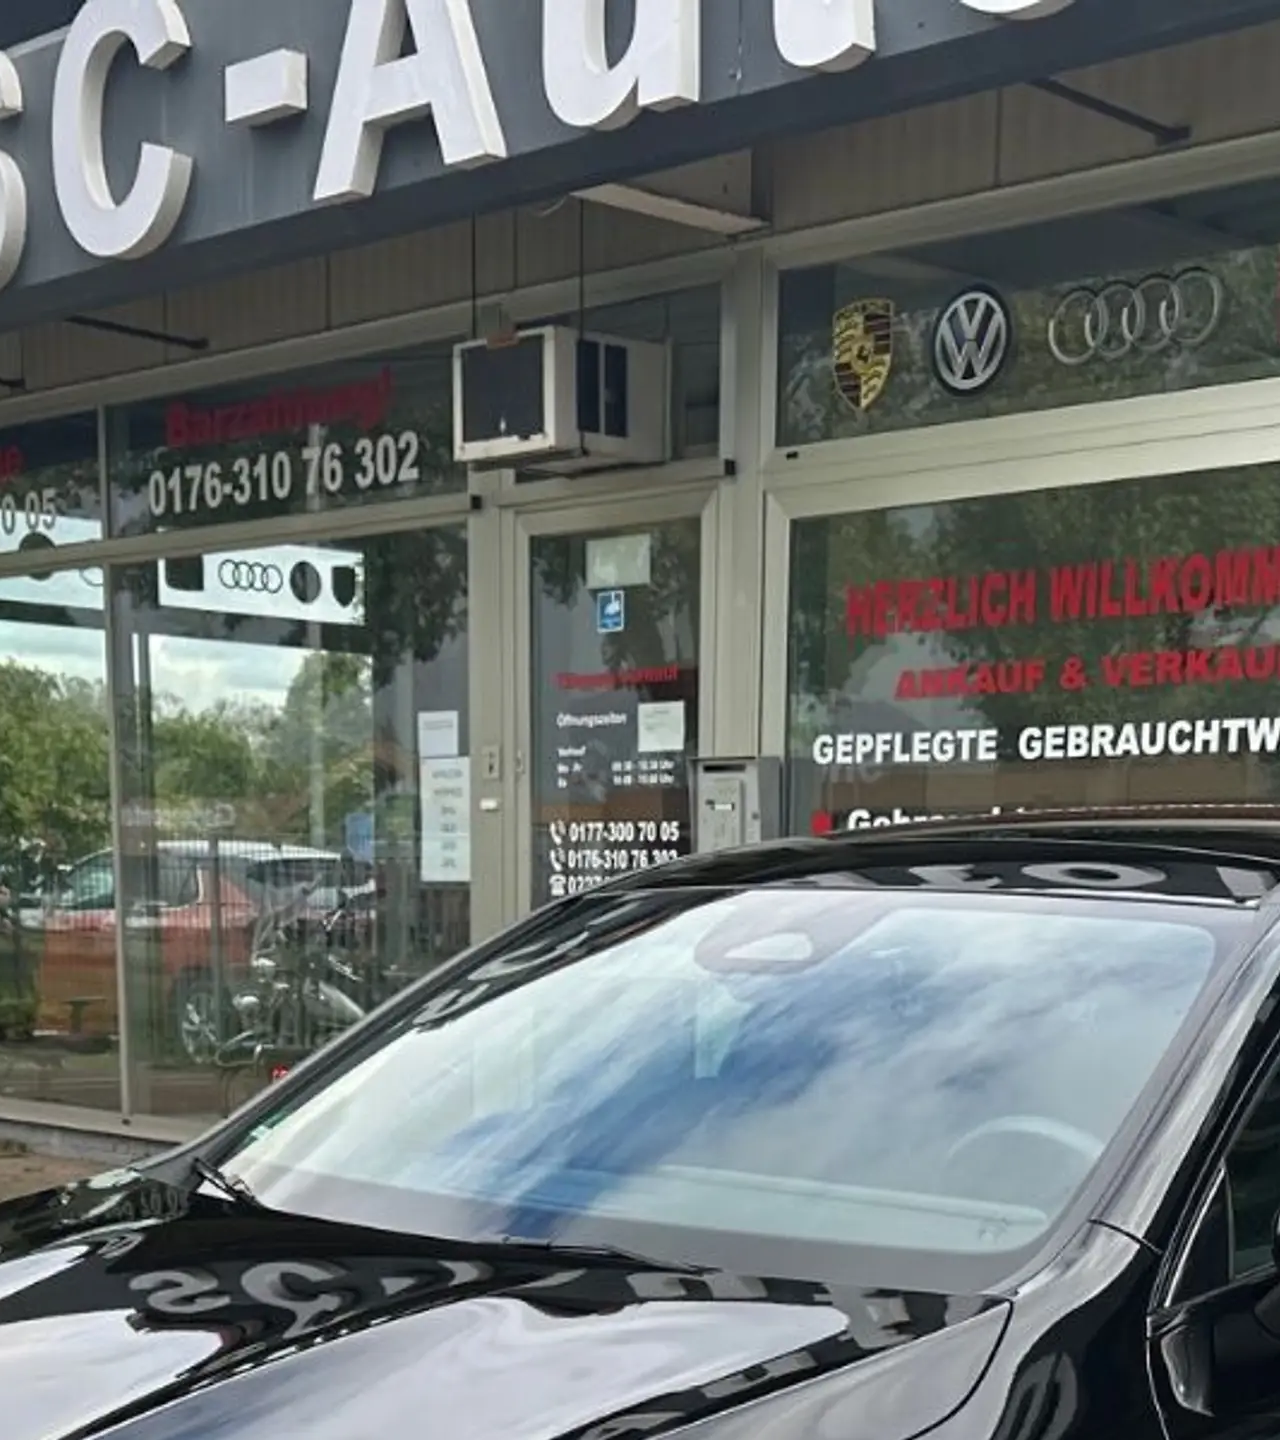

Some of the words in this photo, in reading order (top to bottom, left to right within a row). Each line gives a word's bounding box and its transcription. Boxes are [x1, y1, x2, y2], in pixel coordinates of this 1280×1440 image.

[148, 451, 291, 516] 0176-310
[302, 443, 343, 493] 76
[354, 430, 419, 490] 302
[25, 488, 58, 531] 05
[846, 569, 1037, 637] HERZLICH
[894, 659, 1046, 700] ANKAUF
[1058, 655, 1088, 690] &
[813, 728, 997, 765] GEPFLEGTE
[570, 820, 634, 842] 0177-300
[637, 820, 657, 841] 70
[660, 820, 680, 841] 05
